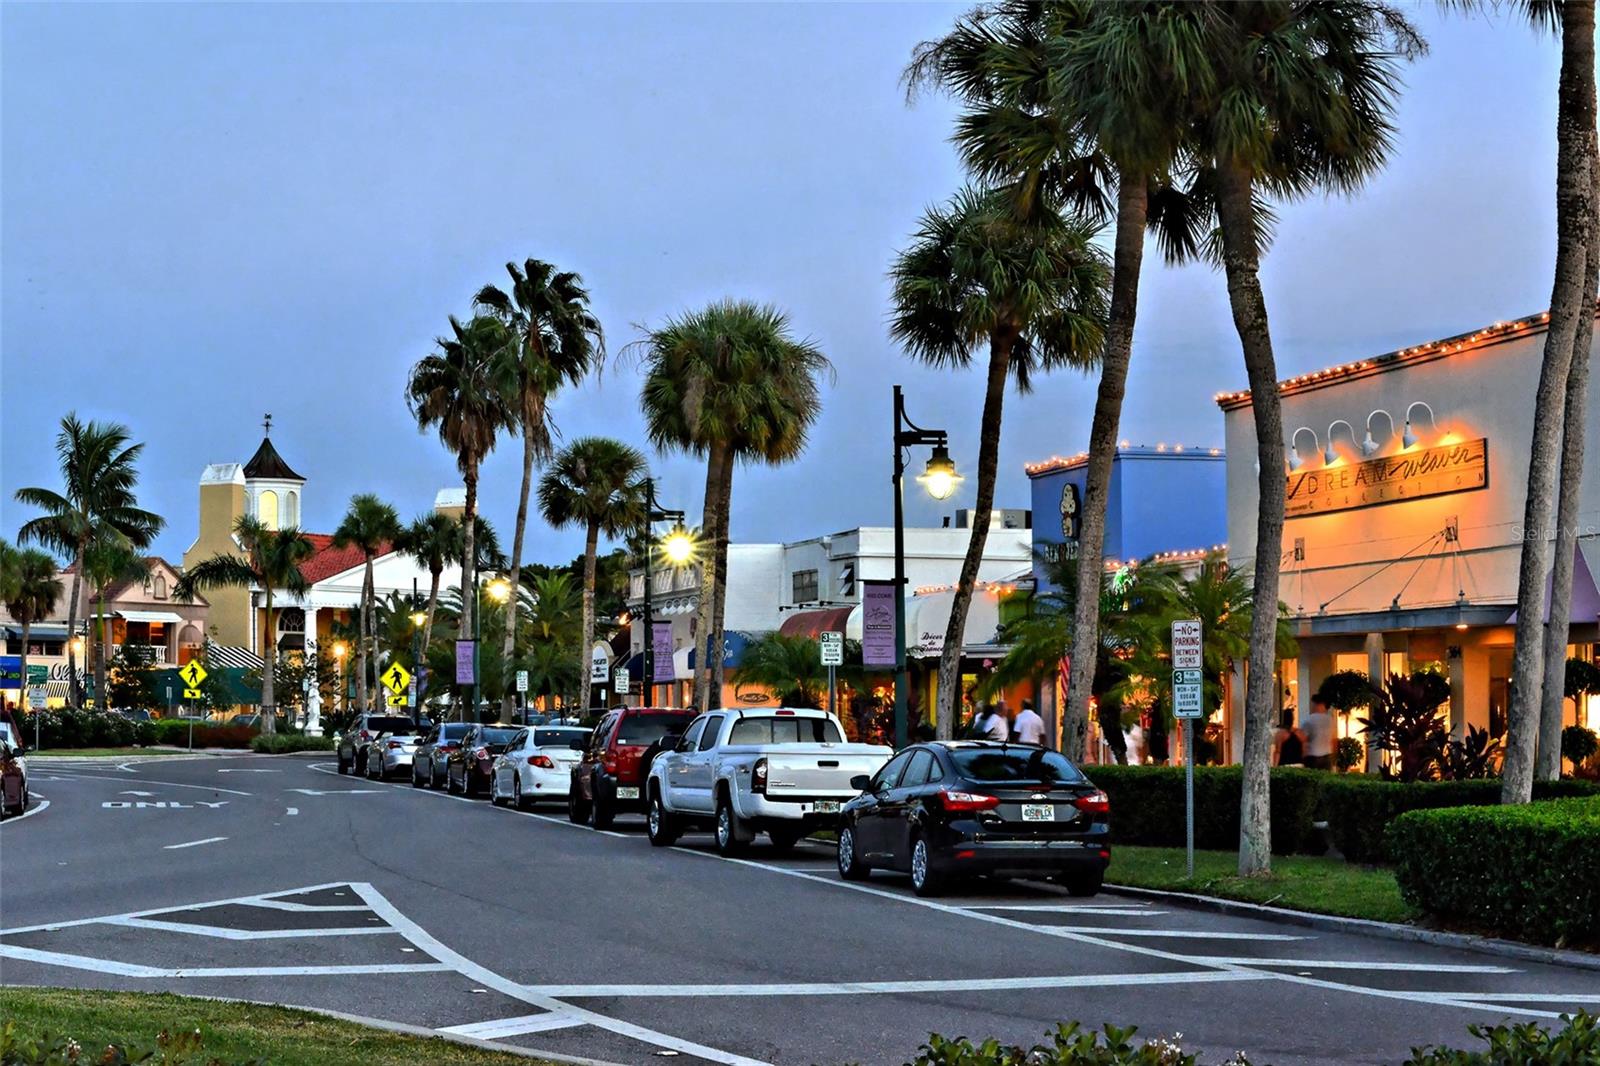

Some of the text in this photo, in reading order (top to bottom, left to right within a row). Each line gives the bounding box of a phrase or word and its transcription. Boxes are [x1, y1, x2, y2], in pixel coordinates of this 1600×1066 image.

[1308, 447, 1482, 494] DREAM weaver
[1181, 626, 1192, 635] NO
[822, 633, 829, 642] 3
[1174, 637, 1199, 646] PARKING
[1175, 672, 1183, 684] 3
